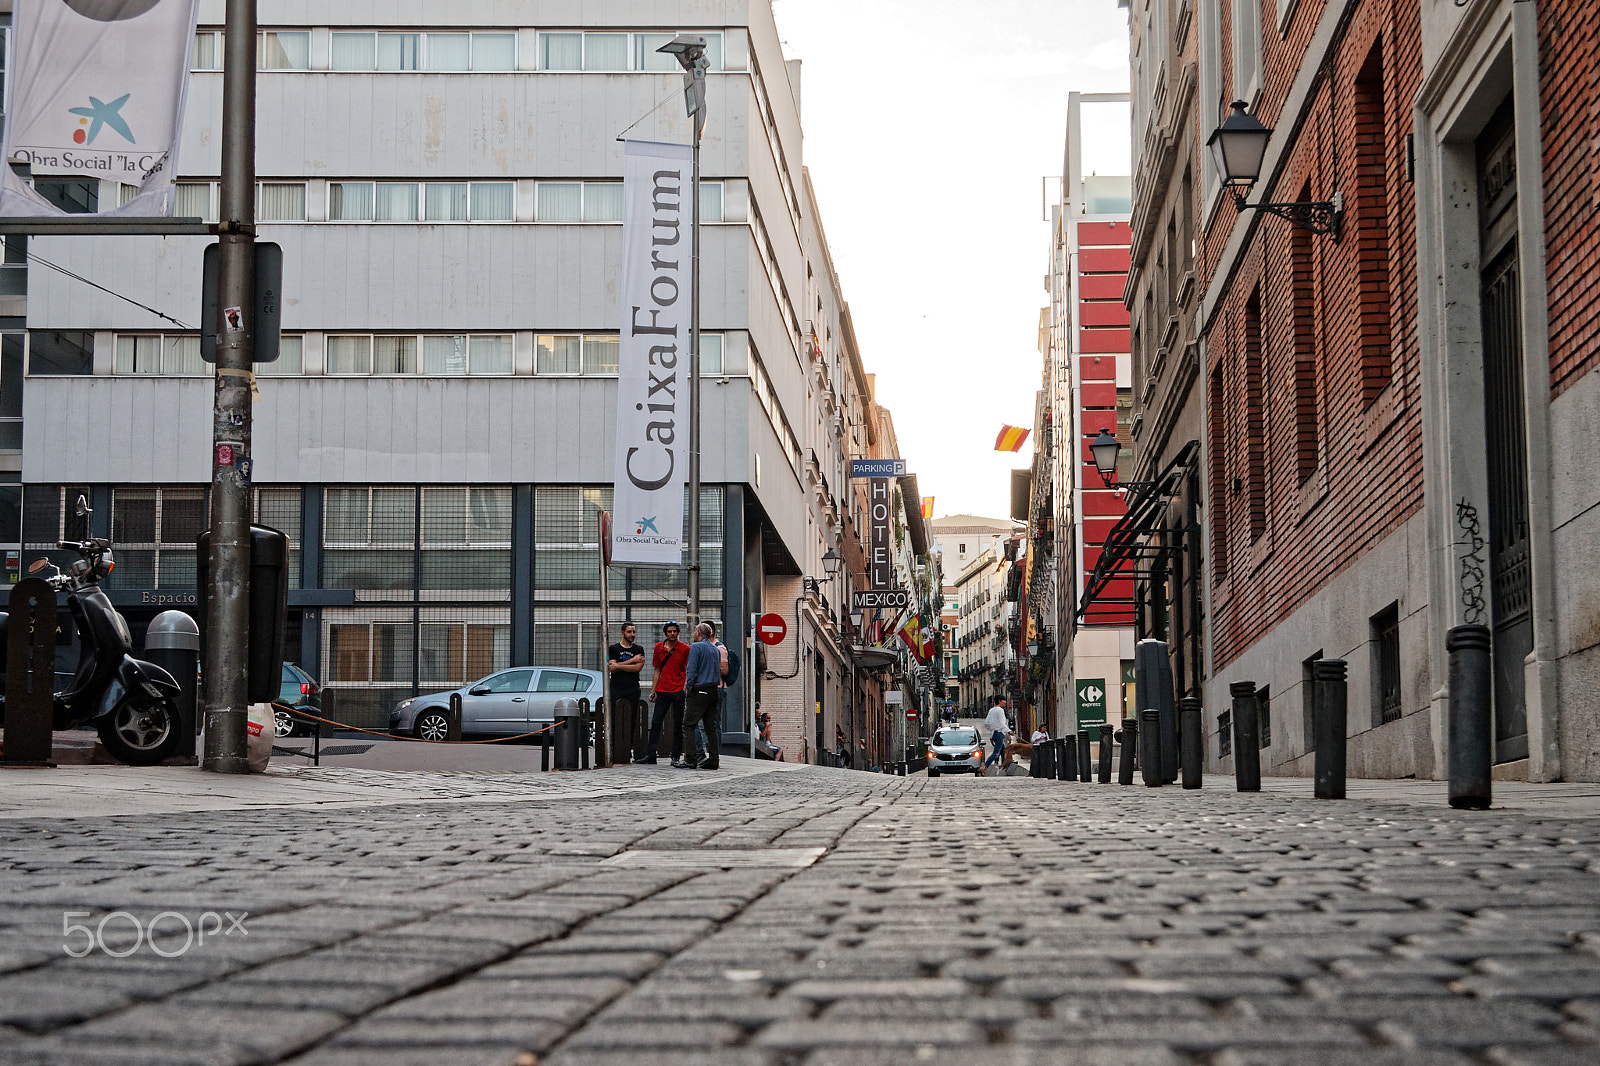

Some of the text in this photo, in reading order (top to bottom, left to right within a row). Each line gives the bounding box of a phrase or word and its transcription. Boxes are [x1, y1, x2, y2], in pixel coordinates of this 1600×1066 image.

[62, 152, 112, 171] Social
[626, 169, 681, 491] CaixaForum
[853, 464, 893, 473] PARKING
[872, 482, 888, 585] HOTEL
[142, 591, 196, 605] Espacio
[854, 592, 907, 606] MEXICO
